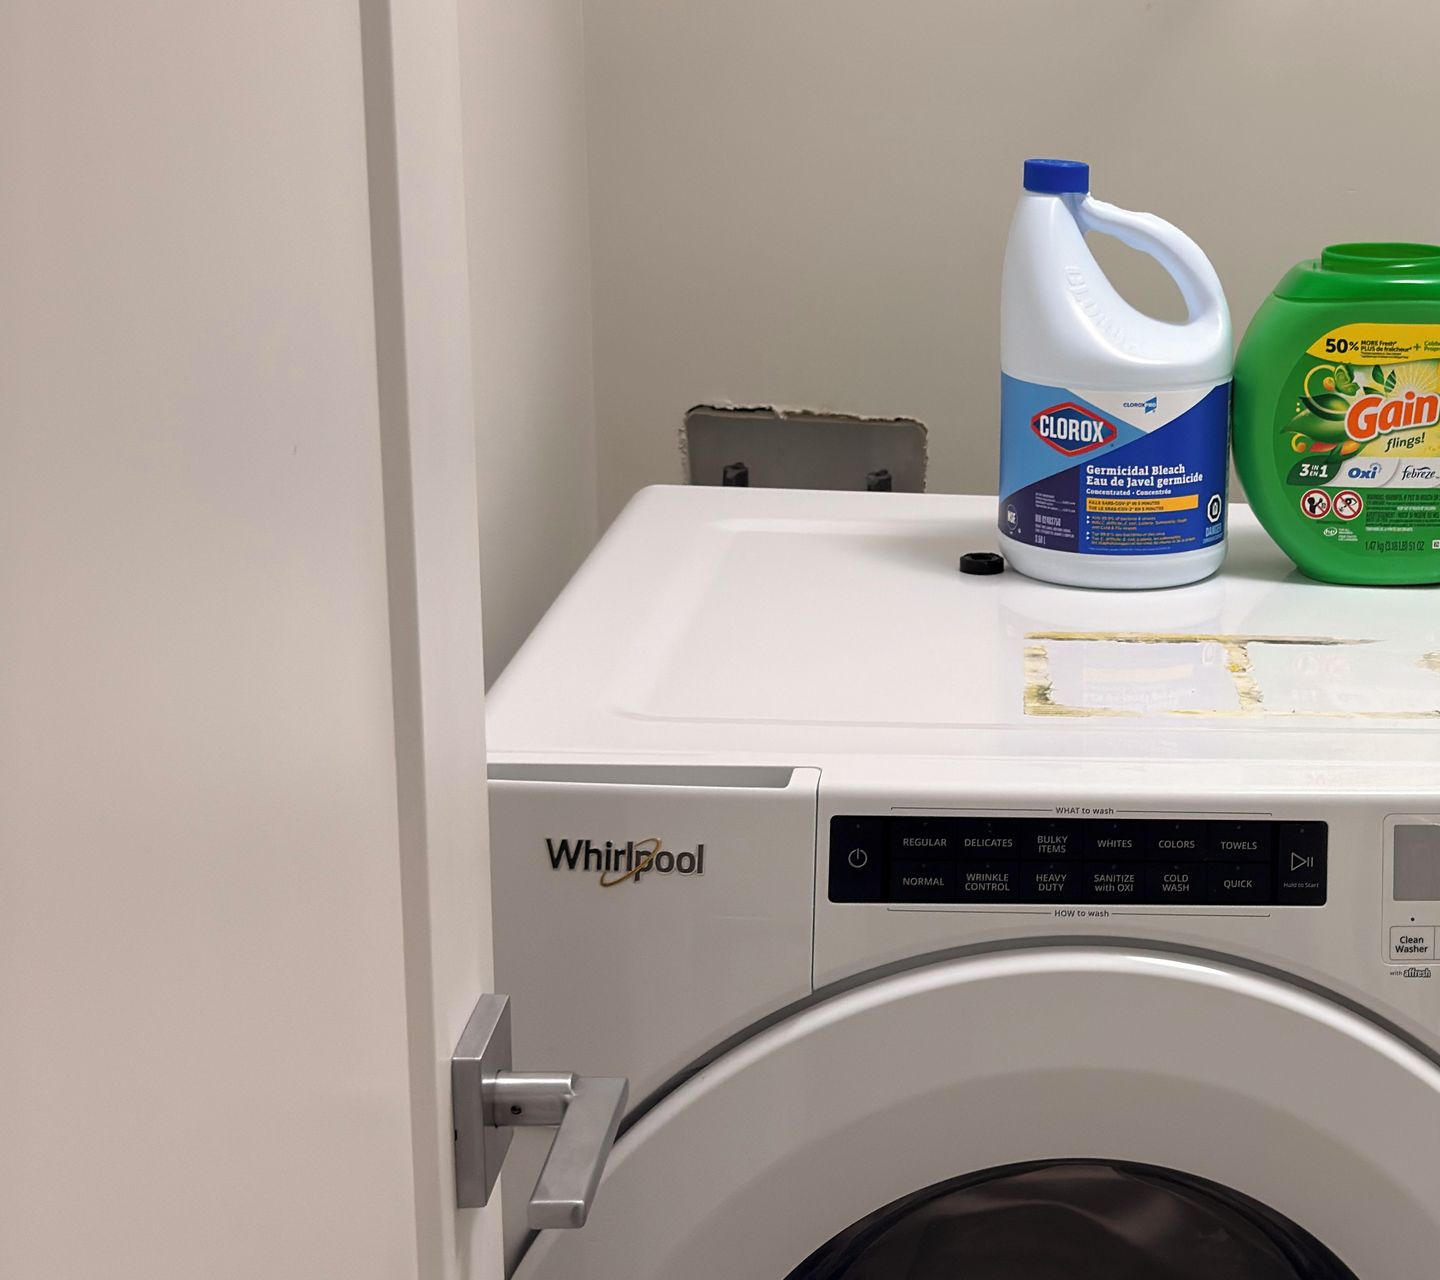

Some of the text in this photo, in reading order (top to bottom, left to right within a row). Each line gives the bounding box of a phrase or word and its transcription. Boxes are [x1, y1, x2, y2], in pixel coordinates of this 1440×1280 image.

[1326, 338, 1359, 353] 50%
[1346, 391, 1439, 440] Gain
[1040, 415, 1104, 443] CLOROX
[1384, 432, 1426, 453] flings!
[1086, 464, 1185, 476] Germicidal Bleach
[1299, 464, 1307, 477] 3
[1401, 465, 1436, 480] febreze
[1086, 472, 1203, 488] Eau de Javel germicide
[1086, 488, 1131, 496] Concentrated
[1377, 541, 1384, 553] kg
[1055, 806, 1114, 815] WHAT to wash
[903, 838, 947, 847] REGULAR
[964, 838, 1013, 848] DELICATES
[1037, 835, 1068, 844] BULKY
[1097, 839, 1132, 848] WHITES
[1158, 840, 1195, 849] COLORS
[1038, 844, 1066, 854] ITEMS
[1220, 841, 1257, 850] TOWELS
[545, 837, 705, 884] Whirlpool
[902, 877, 945, 886] NORMAL
[966, 873, 1009, 882] WRINKLE
[1036, 873, 1067, 883] HEAVY
[1093, 874, 1135, 883] SANITIZE
[1163, 874, 1189, 883] COLD
[965, 882, 1010, 892] CONTROL
[1038, 882, 1064, 892] DUTY
[1094, 883, 1134, 893] with OXI
[1162, 883, 1190, 892] WASH
[1223, 879, 1252, 889] QUICK
[1054, 909, 1110, 918] HOW to wash
[1399, 935, 1424, 944] Clean
[1395, 945, 1429, 953] Washer
[1403, 968, 1431, 978] affresh
